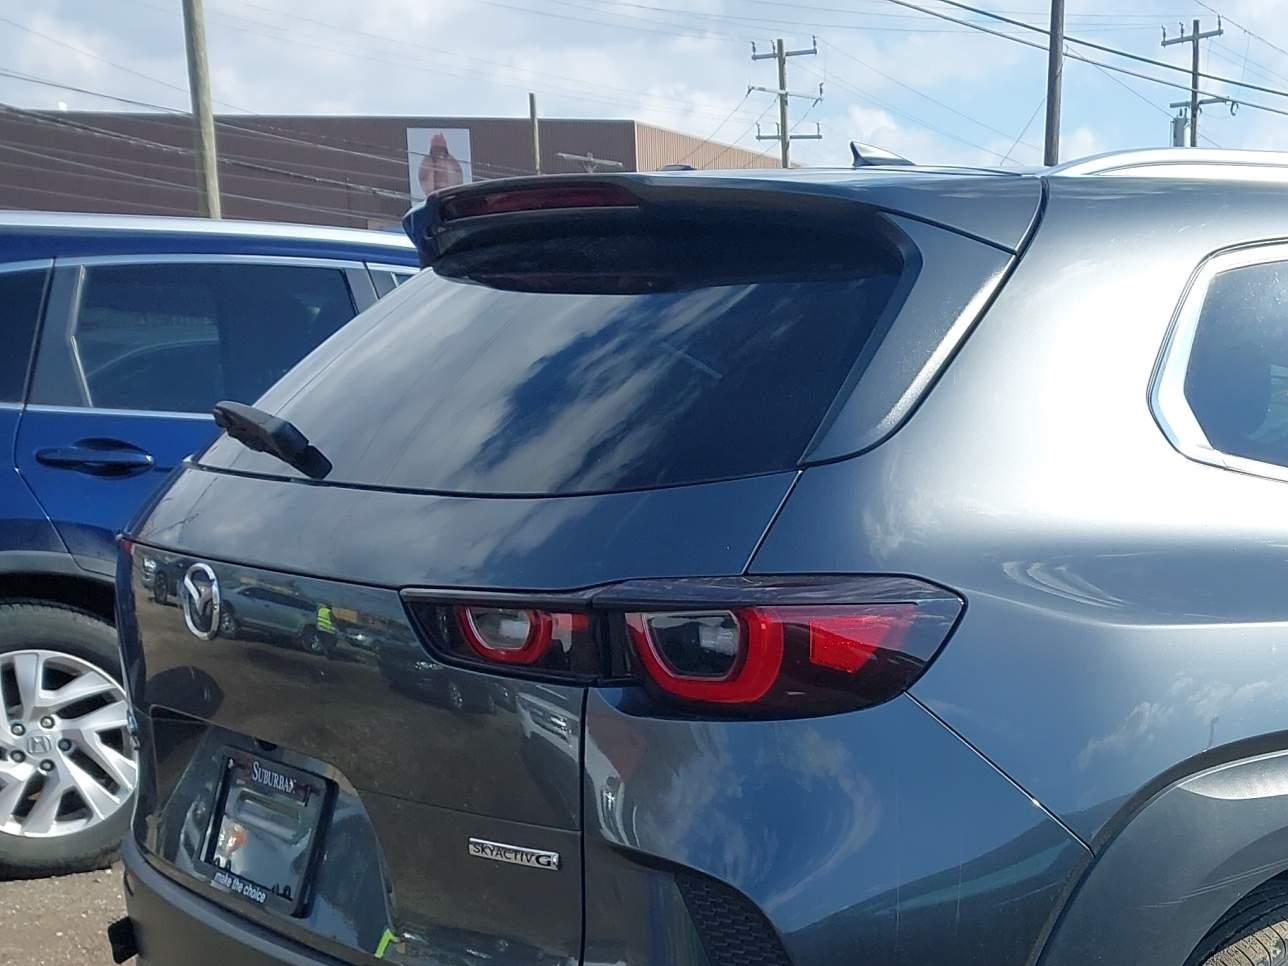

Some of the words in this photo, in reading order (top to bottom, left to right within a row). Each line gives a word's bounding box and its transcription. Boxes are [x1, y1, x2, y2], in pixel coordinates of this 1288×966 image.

[213, 872, 232, 888] make
[231, 878, 244, 893] the
[243, 883, 266, 903] choice
